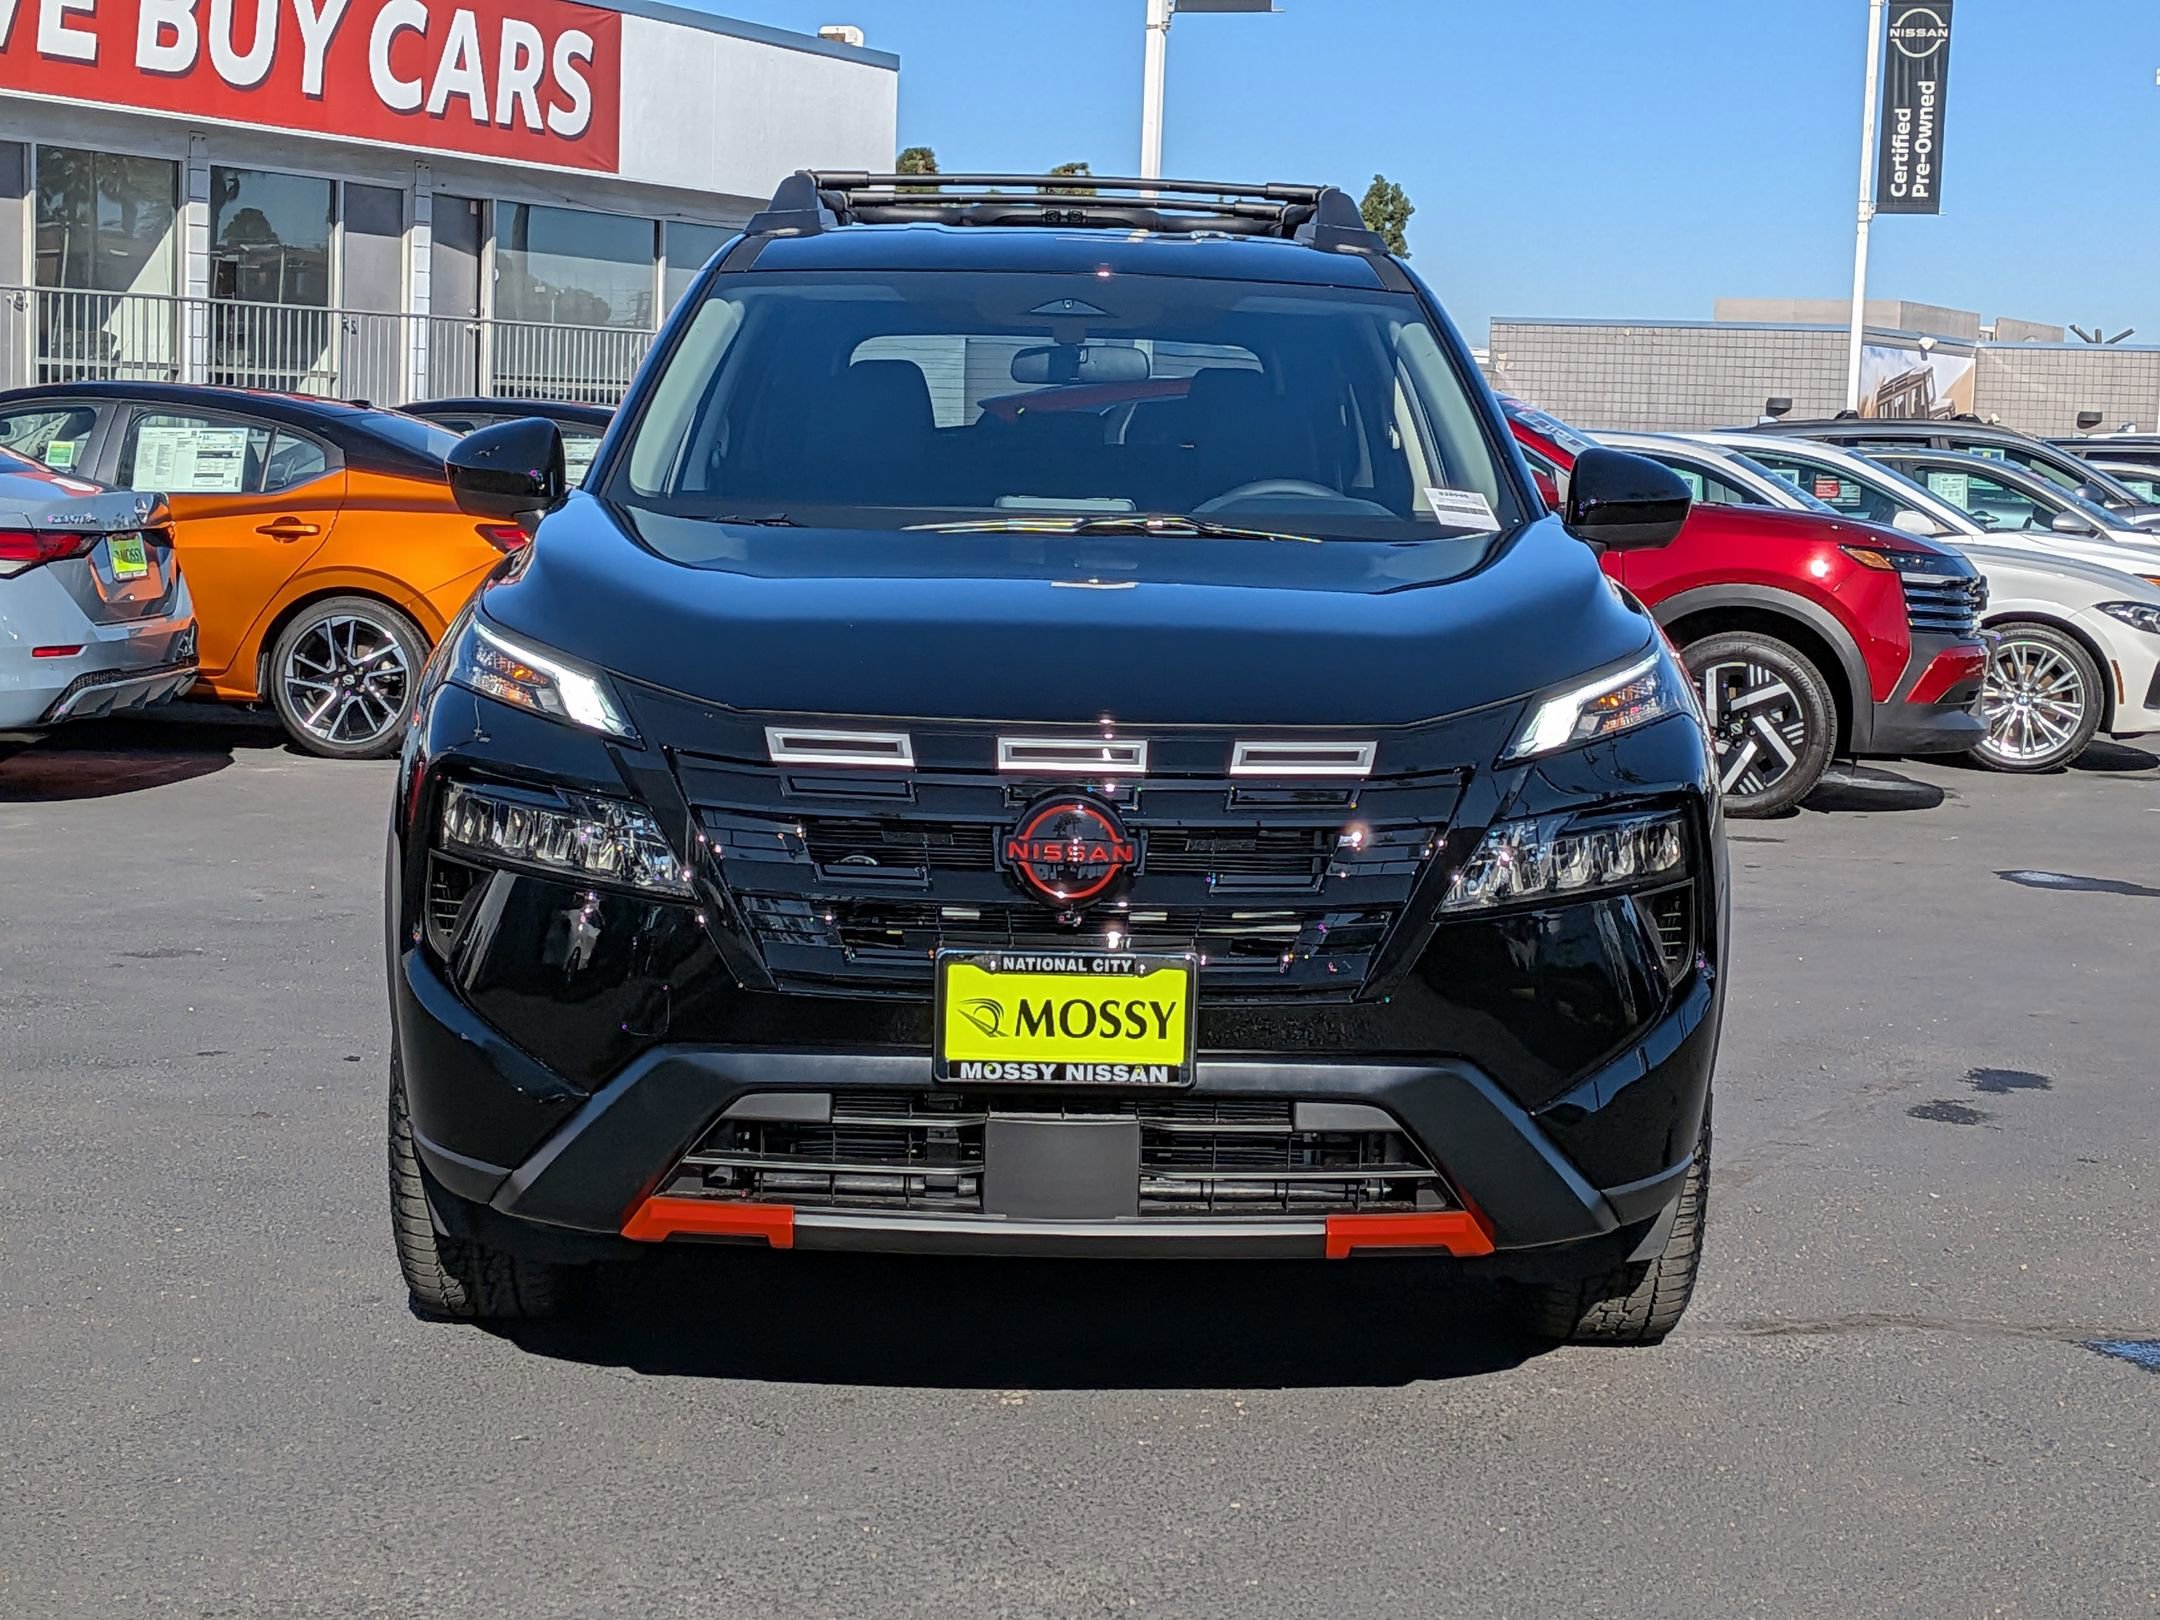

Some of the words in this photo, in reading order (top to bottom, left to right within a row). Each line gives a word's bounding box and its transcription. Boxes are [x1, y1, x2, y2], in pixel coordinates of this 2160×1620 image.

[1889, 28, 1949, 38] NISSAN
[0, 0, 98, 62] E
[136, 0, 346, 95] BUY
[368, 0, 594, 136] CARS
[1890, 108, 1912, 198] Certified
[1911, 80, 1936, 198] Pre-Owned
[1008, 842, 1133, 862] NISSAN
[1003, 957, 1087, 973] NATIONAL
[1092, 958, 1133, 974] CITY
[1014, 998, 1177, 1040] MOSSY
[960, 1062, 1057, 1080] MOSSY
[1065, 1064, 1168, 1083] NISSAN
